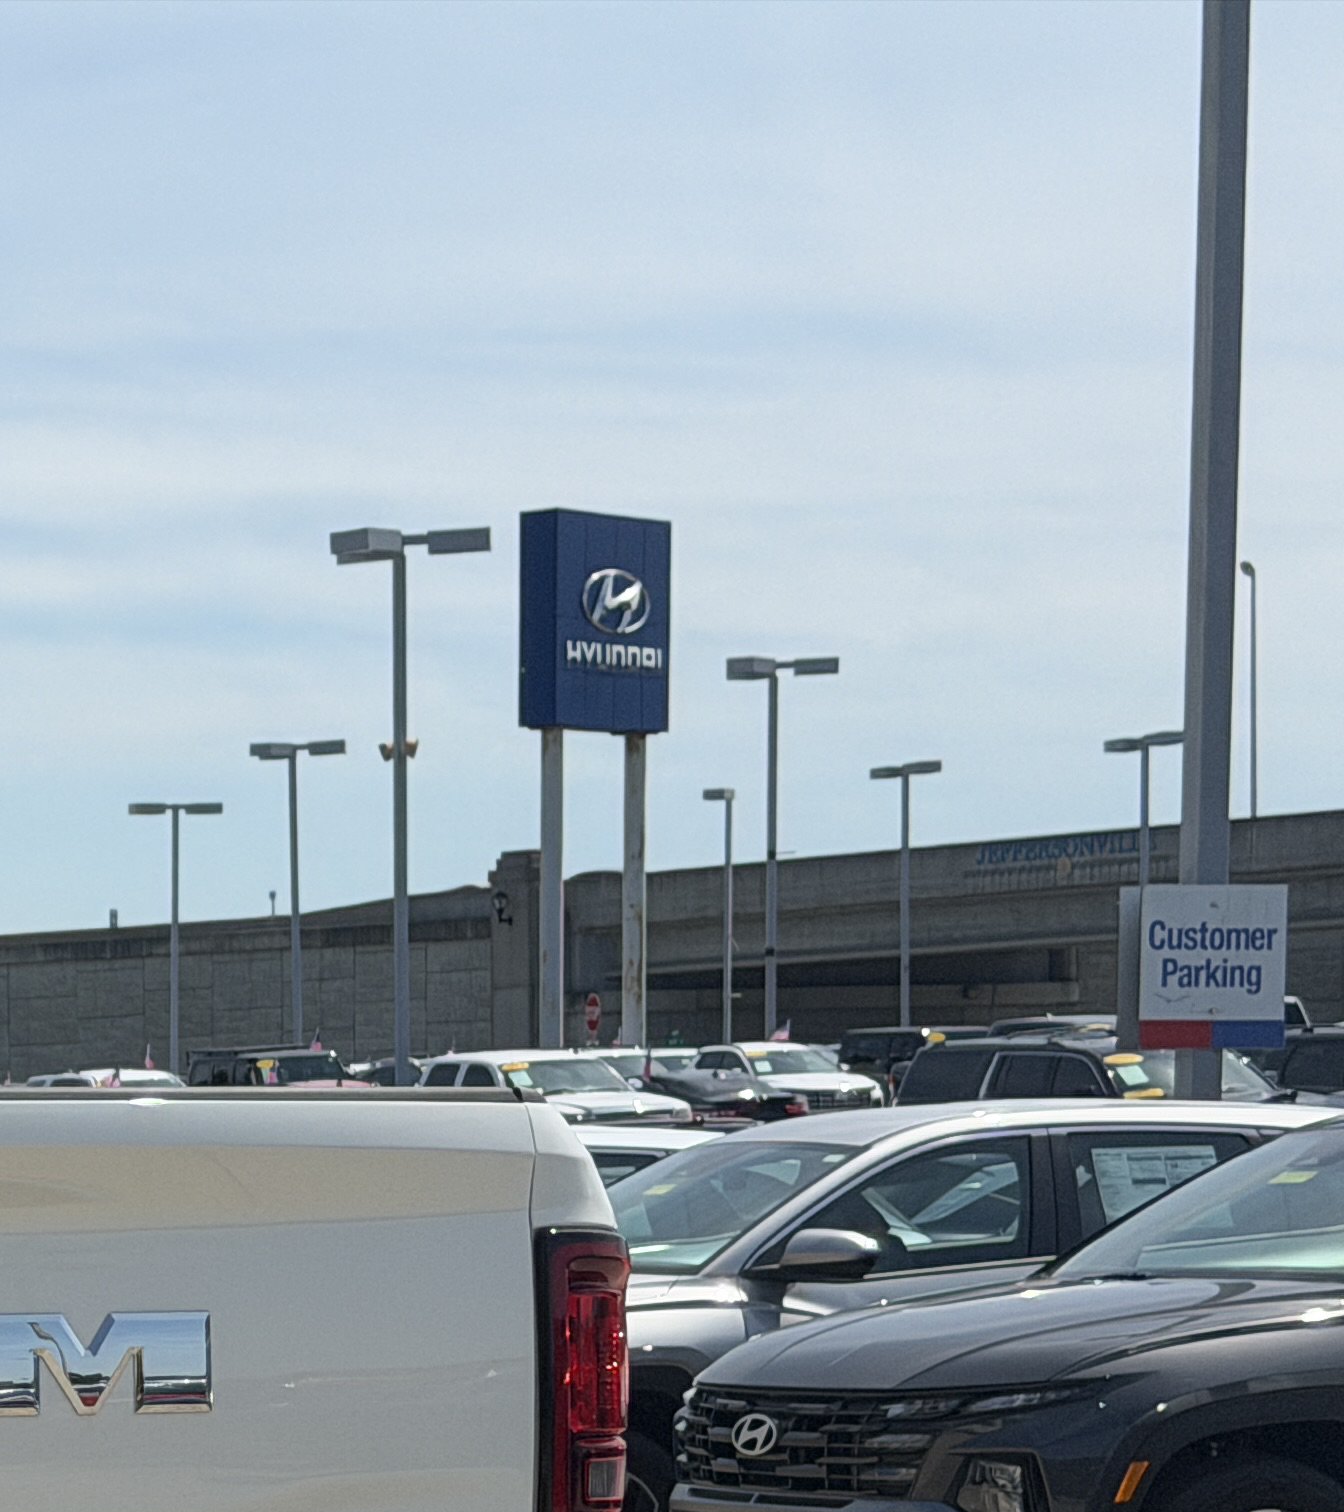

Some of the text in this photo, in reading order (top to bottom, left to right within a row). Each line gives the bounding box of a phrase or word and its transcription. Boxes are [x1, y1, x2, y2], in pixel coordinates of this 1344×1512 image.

[566, 639, 662, 669] HYUNDAI
[1148, 920, 1278, 951] Customer
[1161, 957, 1262, 995] Parking
